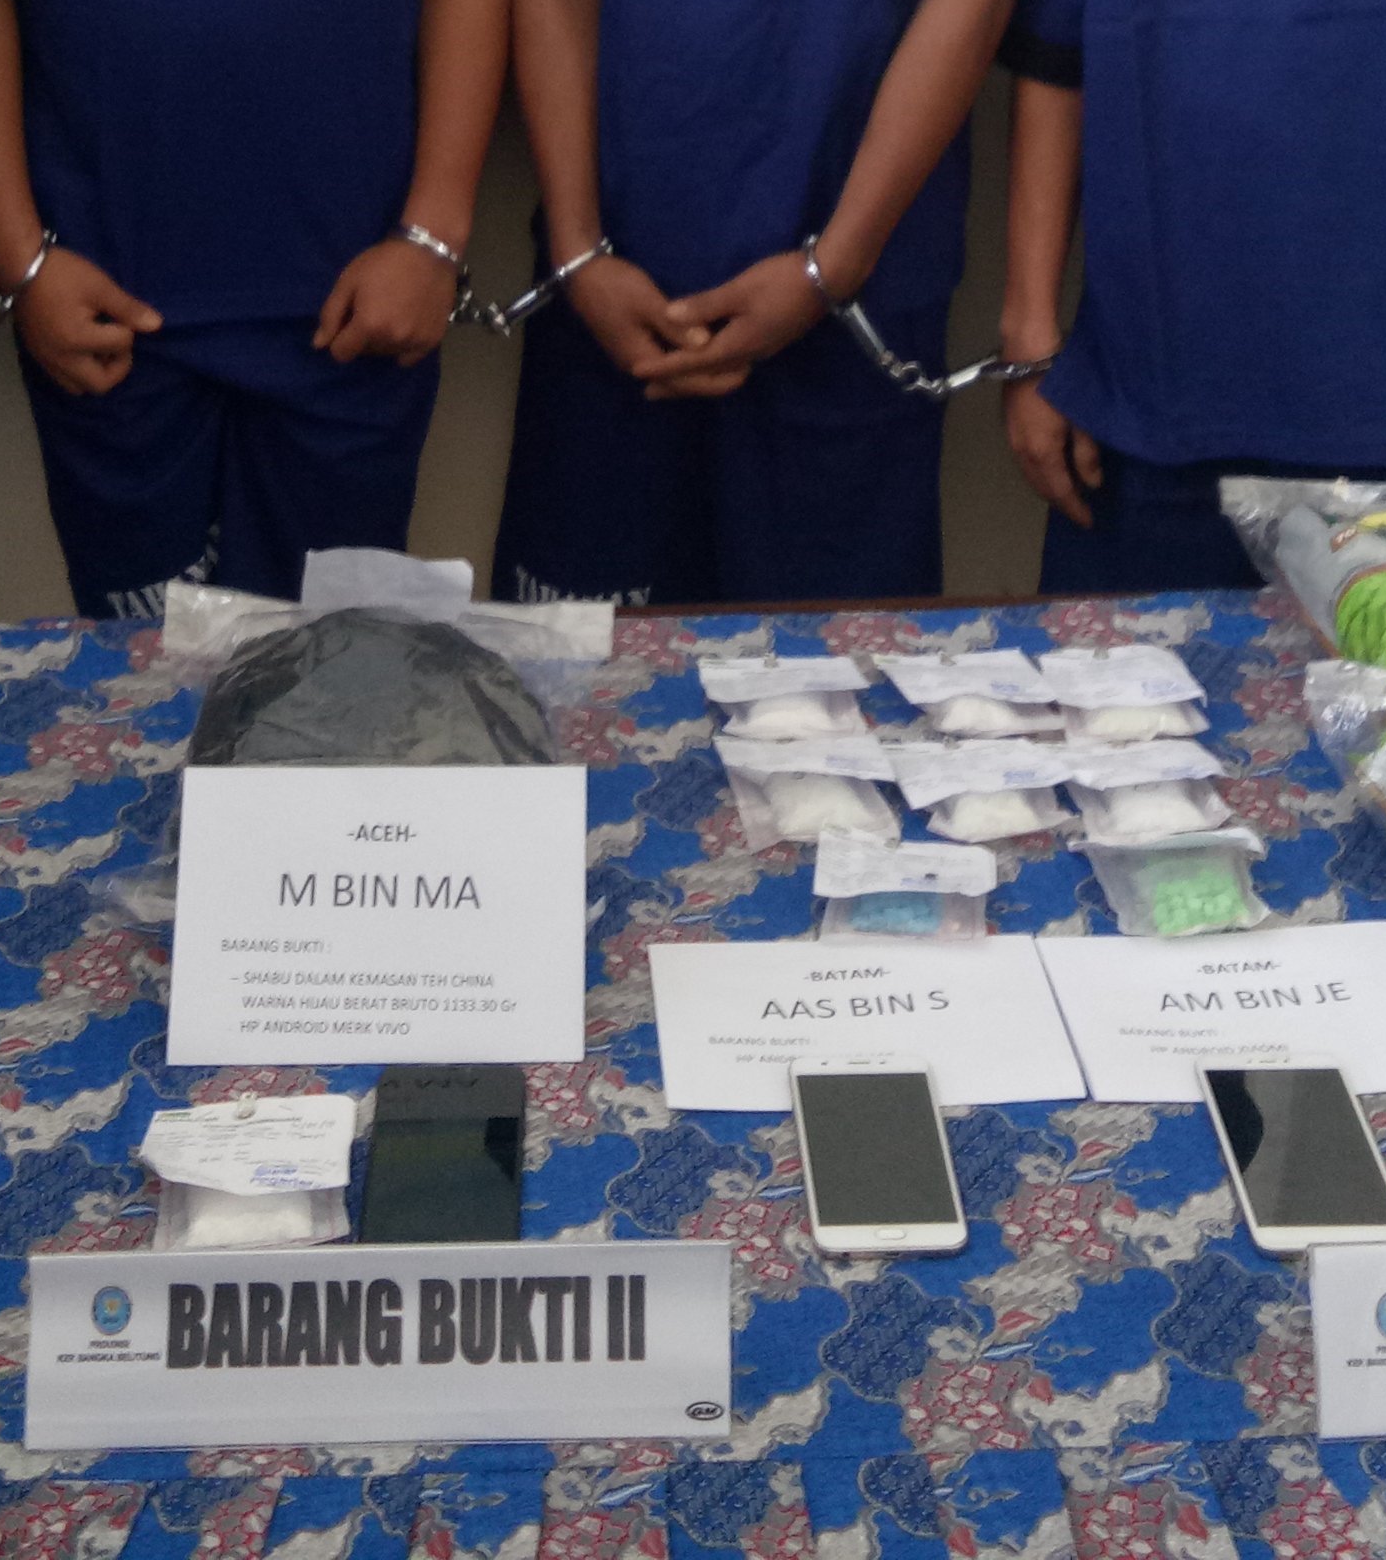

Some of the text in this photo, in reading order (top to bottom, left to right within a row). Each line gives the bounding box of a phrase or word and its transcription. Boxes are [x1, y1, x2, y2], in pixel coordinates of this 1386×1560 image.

[279, 873, 482, 909] M BIN MA
[221, 939, 278, 953] BARANG
[243, 971, 290, 985] SHABU
[295, 971, 346, 986] DALAM
[349, 972, 417, 987] KEMASAN
[422, 974, 448, 988] TEH
[451, 974, 495, 989] CHINA
[242, 996, 296, 1010] WARNA
[343, 997, 388, 1011] BERAT
[392, 998, 439, 1012] BRUTO
[761, 990, 950, 1019] AAS BIN S
[1160, 982, 1352, 1012] AM BIN JE
[239, 1020, 411, 1035] HP ANDROID MERK VIVO
[167, 1273, 646, 1369] BARANG BUKTI II
